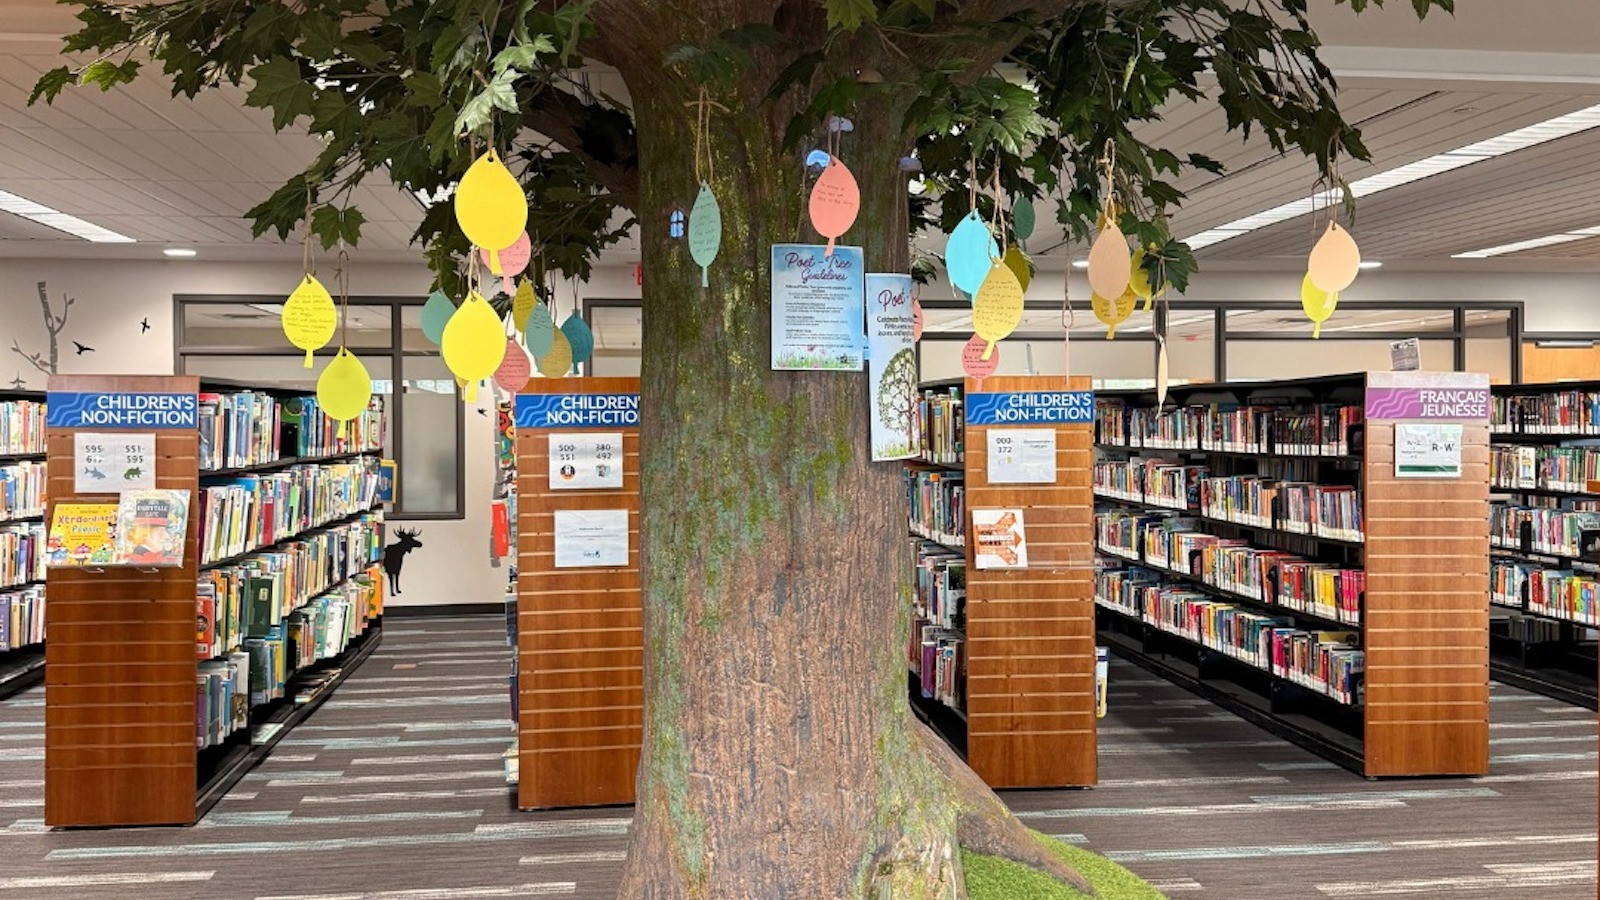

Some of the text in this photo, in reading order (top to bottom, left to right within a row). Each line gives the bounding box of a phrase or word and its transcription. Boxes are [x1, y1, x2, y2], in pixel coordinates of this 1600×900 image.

[785, 252, 815, 269] Poet
[825, 253, 852, 269] Tree
[801, 268, 848, 284] Guidelines
[878, 287, 906, 312] Poet
[97, 395, 195, 410] CHILDREN'S
[560, 395, 640, 410] CHILDREN'
[1008, 393, 1091, 407] CHILDREN'S
[1420, 390, 1487, 405] FRANÇAIS
[81, 410, 193, 425] NON-FICTION
[547, 410, 640, 424] NON-FICTIO
[995, 407, 1091, 420] NON-FICTION
[1420, 405, 1486, 417] JEUNESSE
[126, 455, 144, 463] 595
[560, 453, 575, 461] 551
